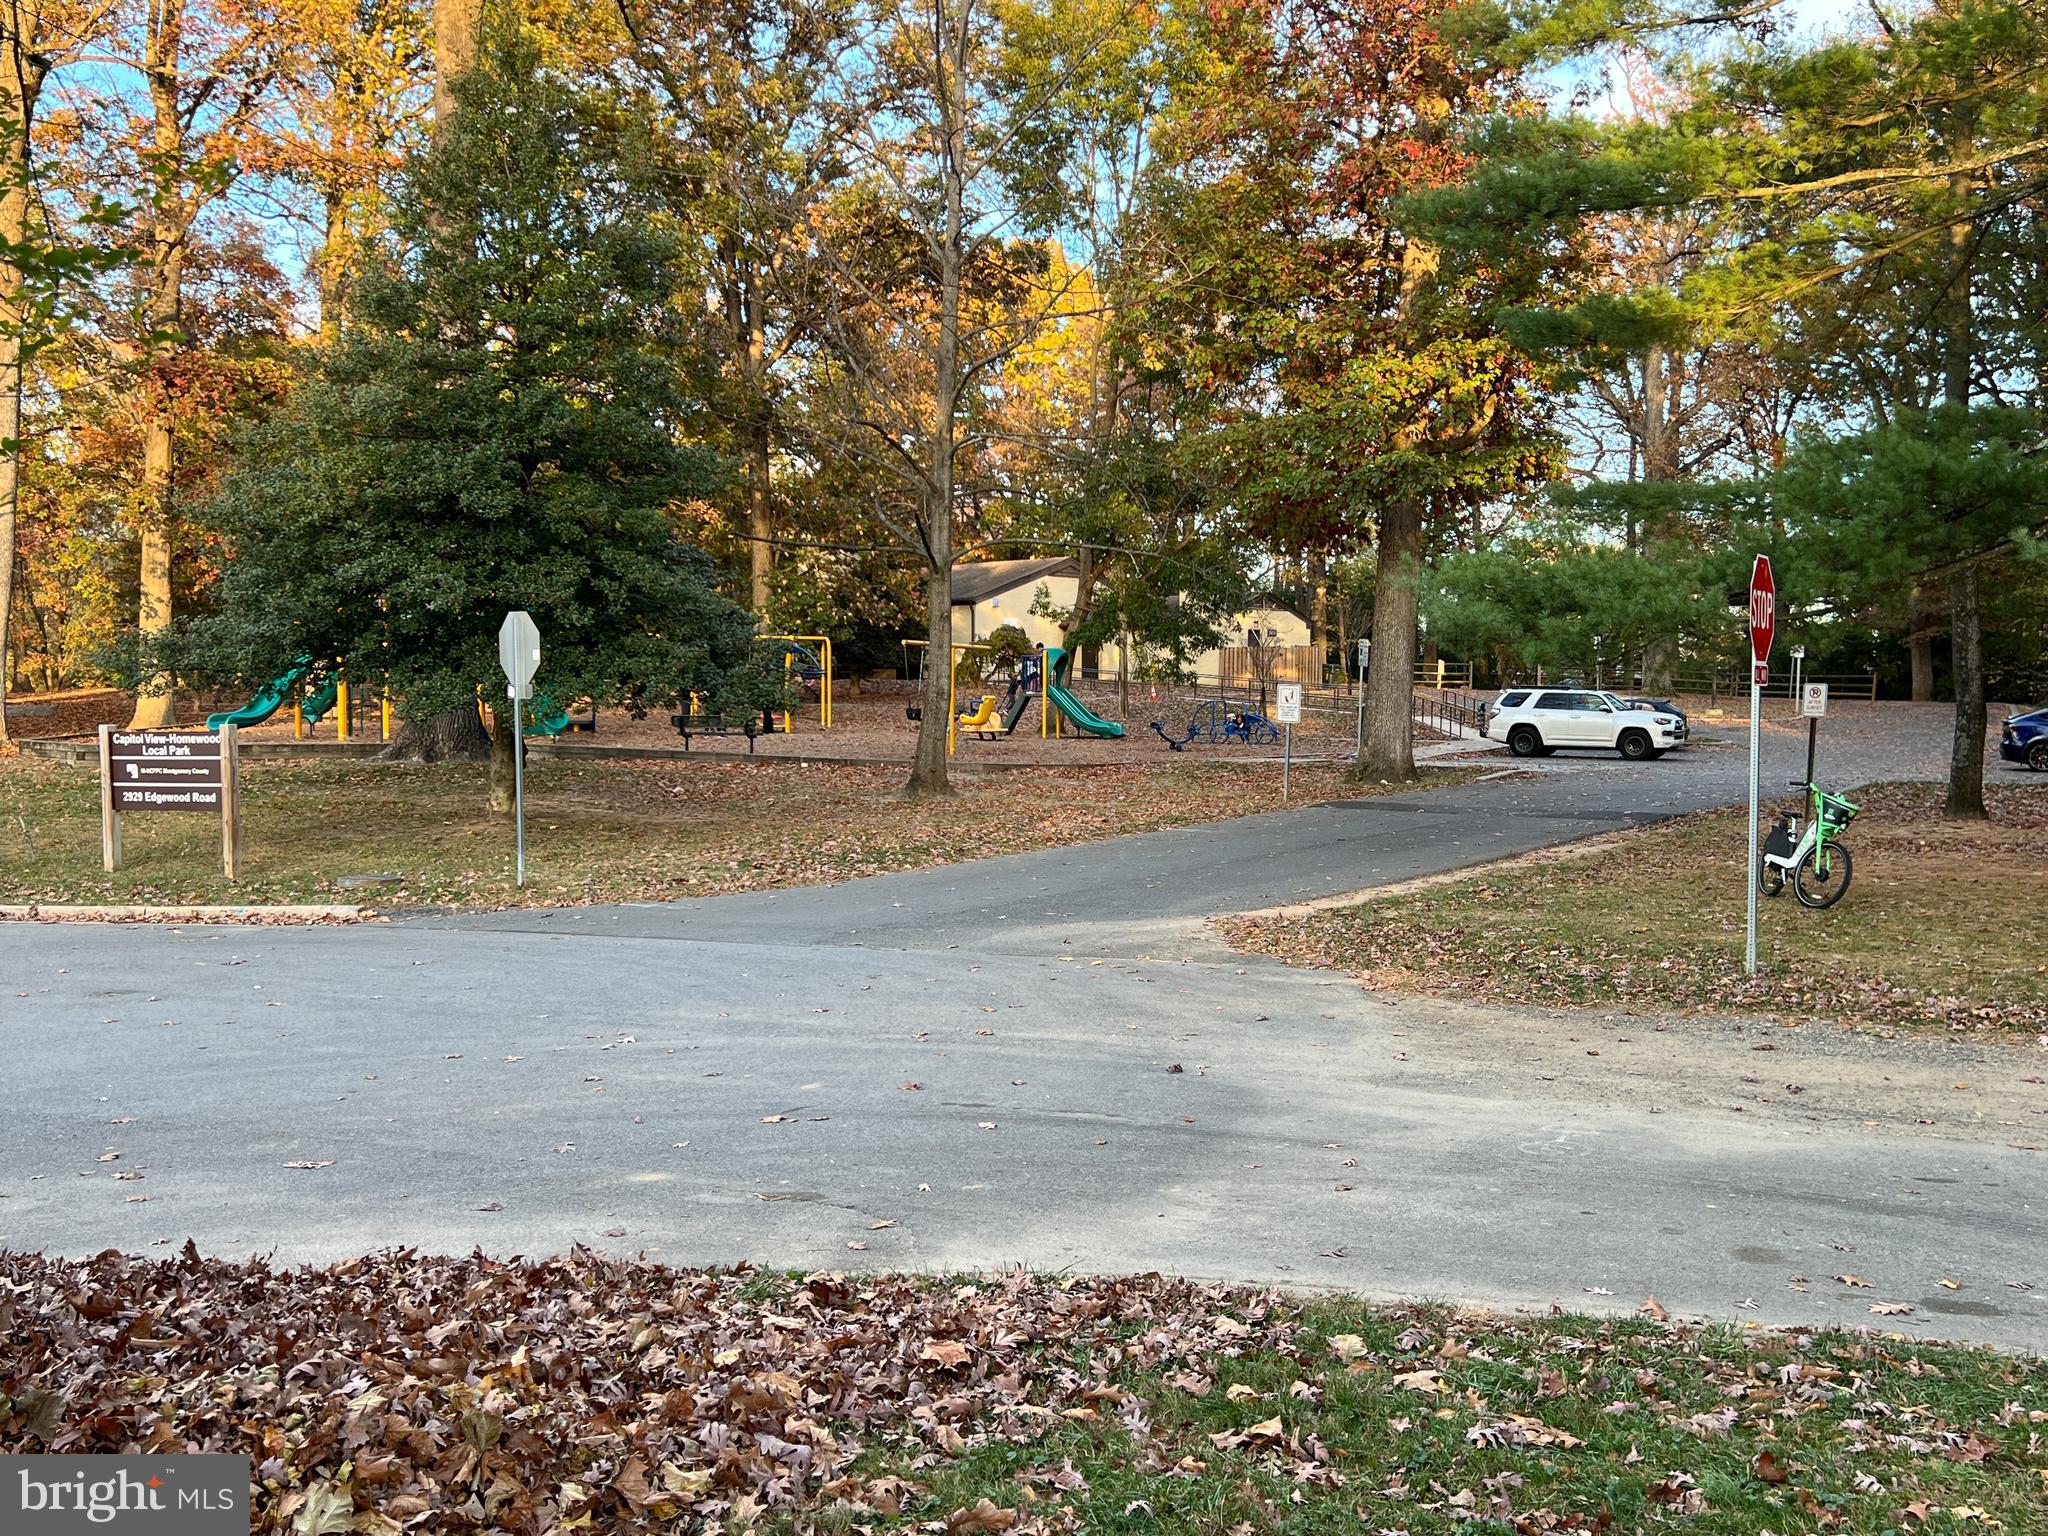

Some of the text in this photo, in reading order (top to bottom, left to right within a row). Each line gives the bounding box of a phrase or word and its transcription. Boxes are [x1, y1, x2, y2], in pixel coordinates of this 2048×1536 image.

[1752, 589, 1773, 630] STOP
[112, 733, 144, 746] Capitol
[142, 745, 191, 756] Local Park
[191, 767, 210, 775] County
[122, 791, 217, 804] 2929 Edgewood Road
